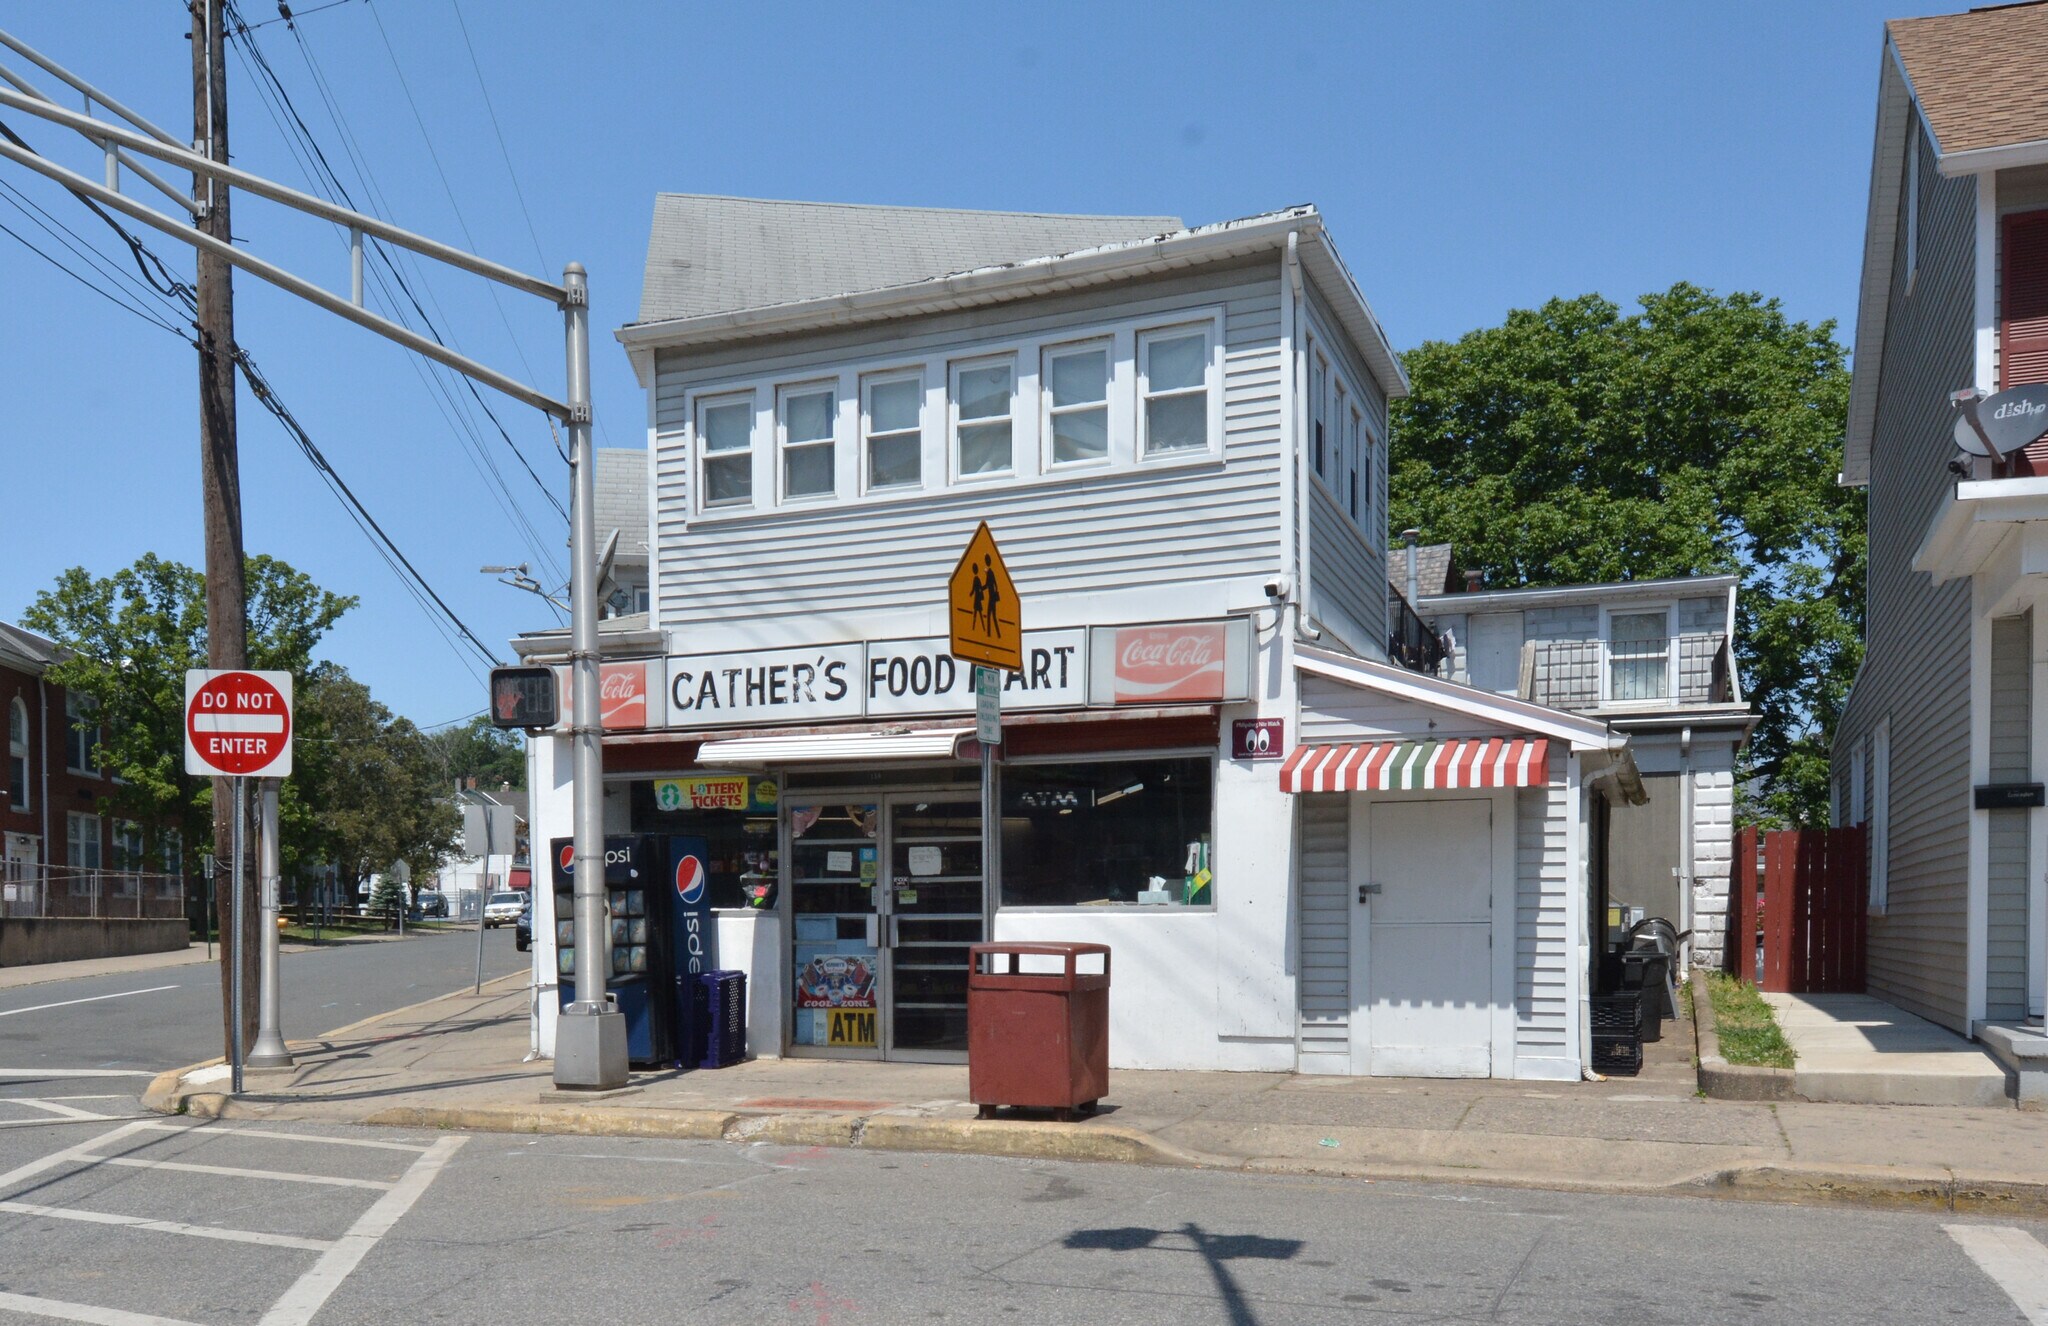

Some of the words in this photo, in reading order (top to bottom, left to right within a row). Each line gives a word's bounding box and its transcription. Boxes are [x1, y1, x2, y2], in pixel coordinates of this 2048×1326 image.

[1994, 399, 2031, 419] dish
[1121, 635, 1215, 668] Coca-Cola
[671, 655, 848, 710] CATHER'S
[869, 654, 956, 698] FOOD
[202, 692, 228, 709] DO
[237, 693, 274, 709] NOT
[210, 738, 267, 754] ENTER
[691, 795, 742, 808] TICKETS
[605, 846, 631, 867] psi
[683, 911, 703, 974] epsi
[803, 1000, 834, 1008] COOL
[840, 1000, 870, 1008] ZONE
[831, 1012, 875, 1042] ATM
